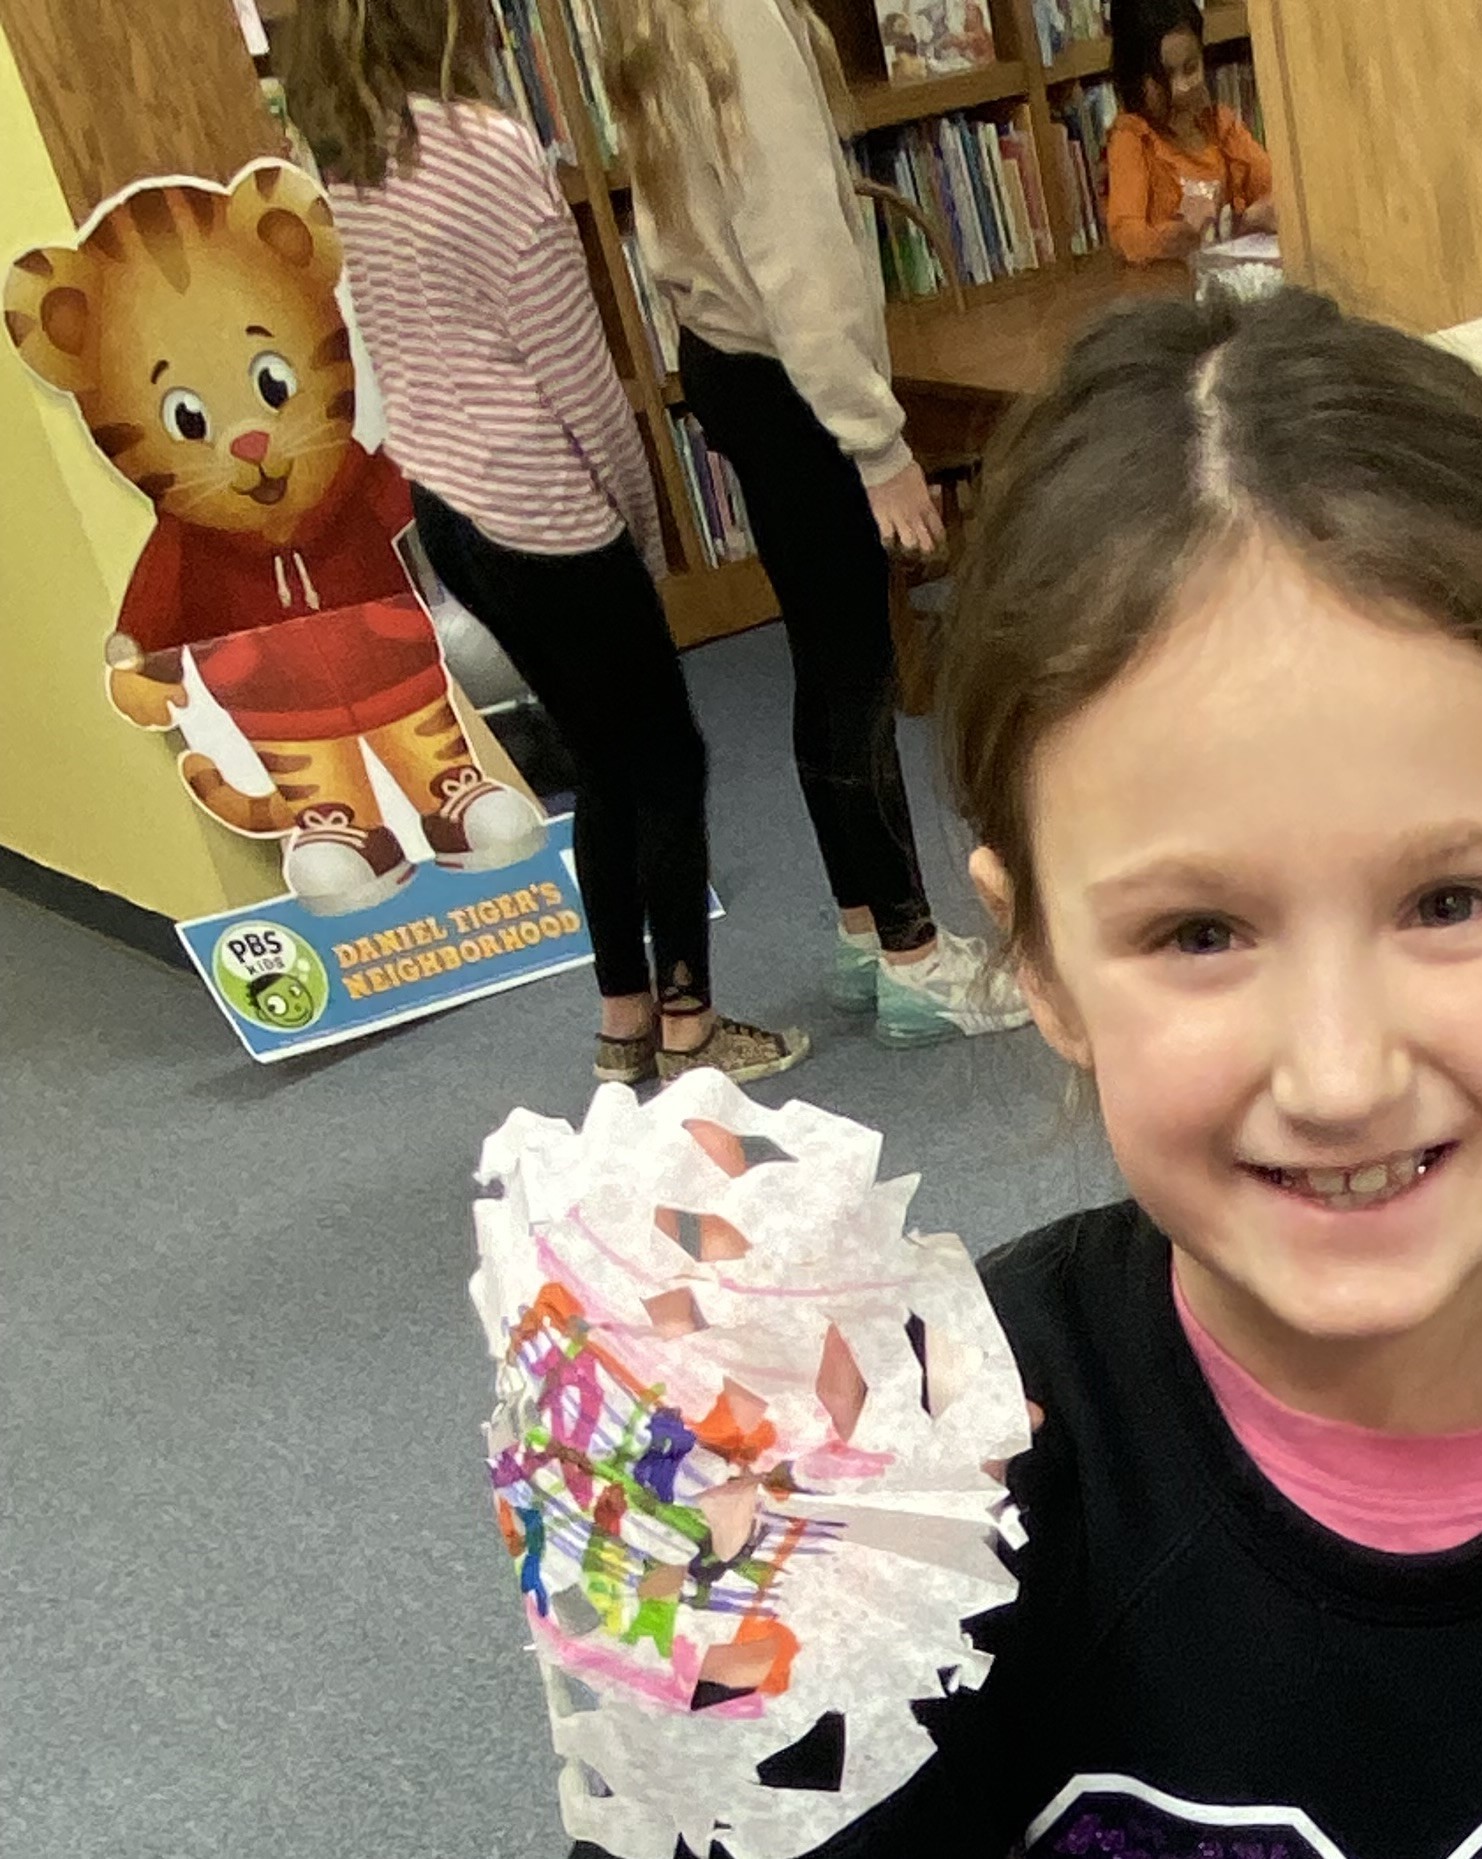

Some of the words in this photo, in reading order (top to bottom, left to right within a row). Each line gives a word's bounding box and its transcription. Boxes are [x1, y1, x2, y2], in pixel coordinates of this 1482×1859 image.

[227, 931, 283, 964] PBS
[332, 916, 448, 968] DANIEL
[447, 882, 562, 934] TIGER'S
[342, 909, 581, 1000] NEIGHBORHOOD
